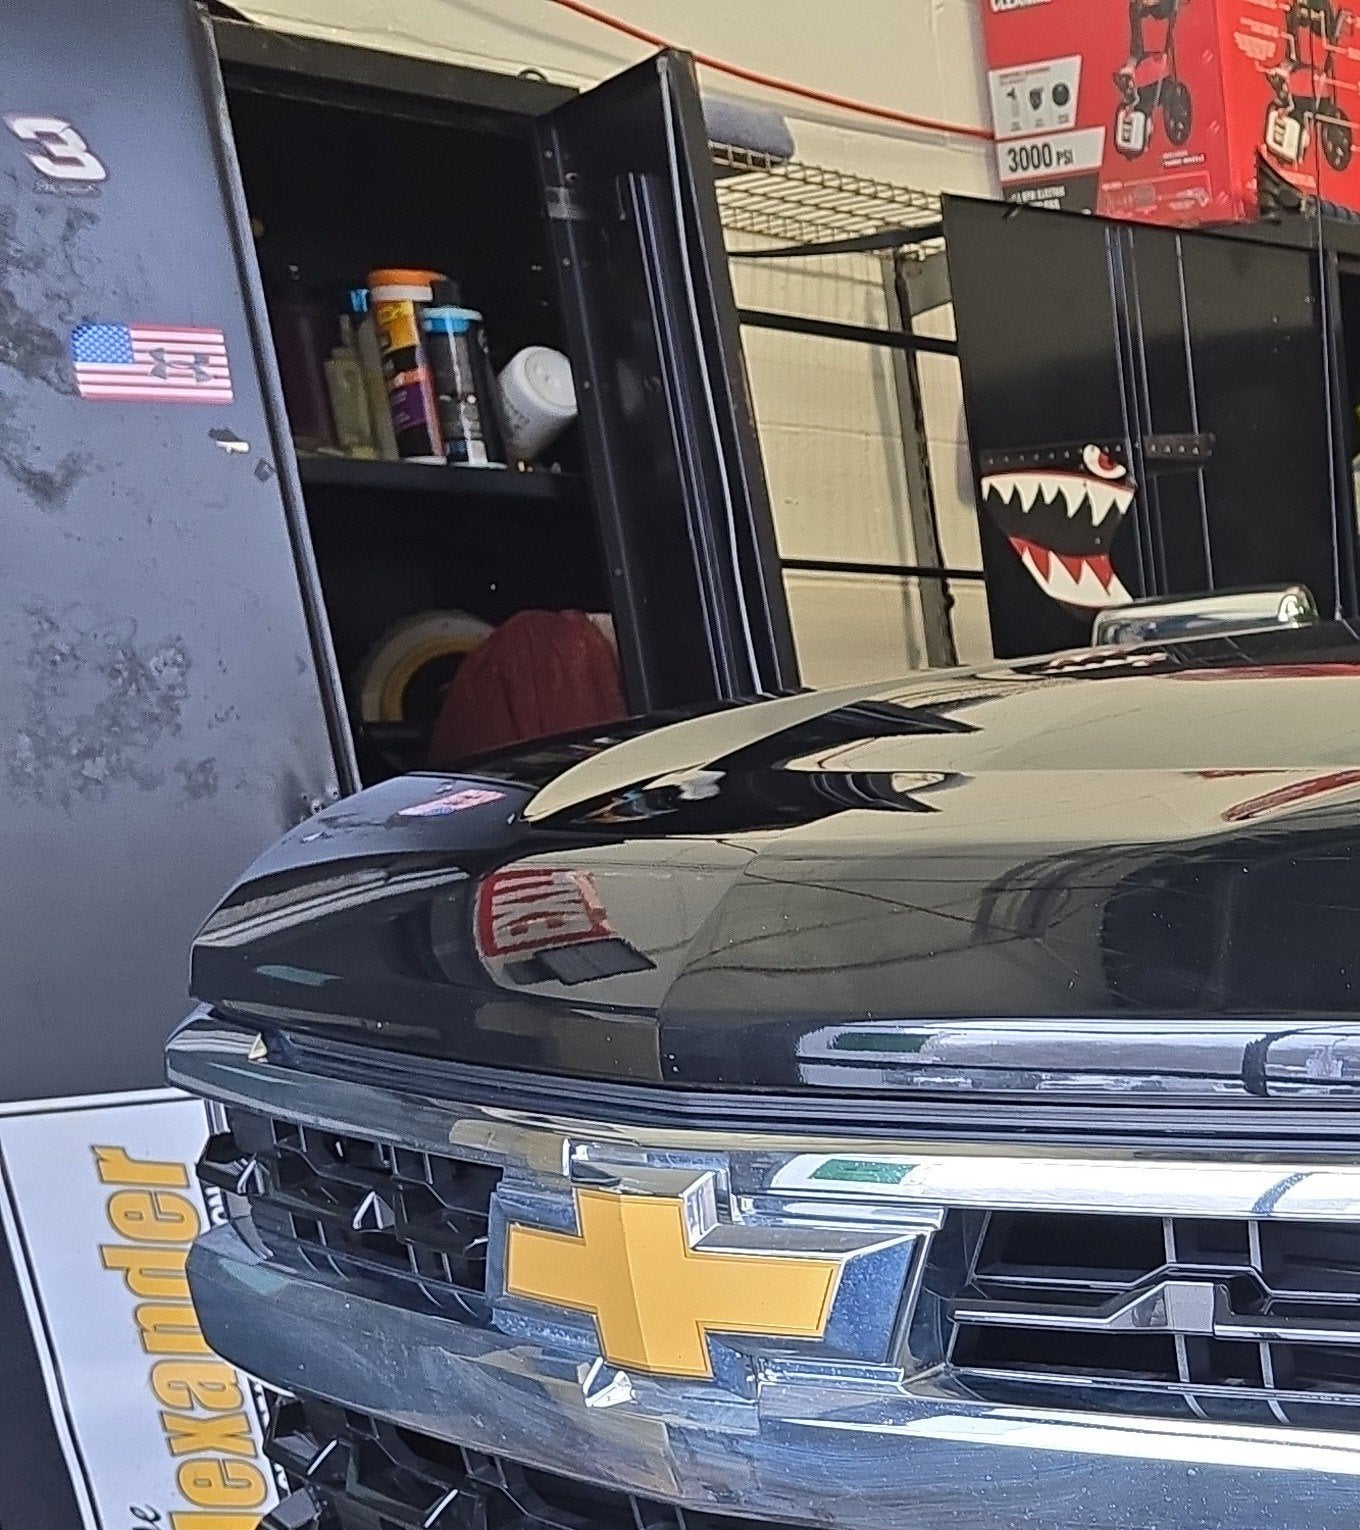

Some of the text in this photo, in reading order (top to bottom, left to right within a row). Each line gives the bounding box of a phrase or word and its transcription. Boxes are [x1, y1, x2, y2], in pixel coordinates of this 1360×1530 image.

[3, 113, 109, 182] 3
[1007, 142, 1074, 172] 3000 PSI
